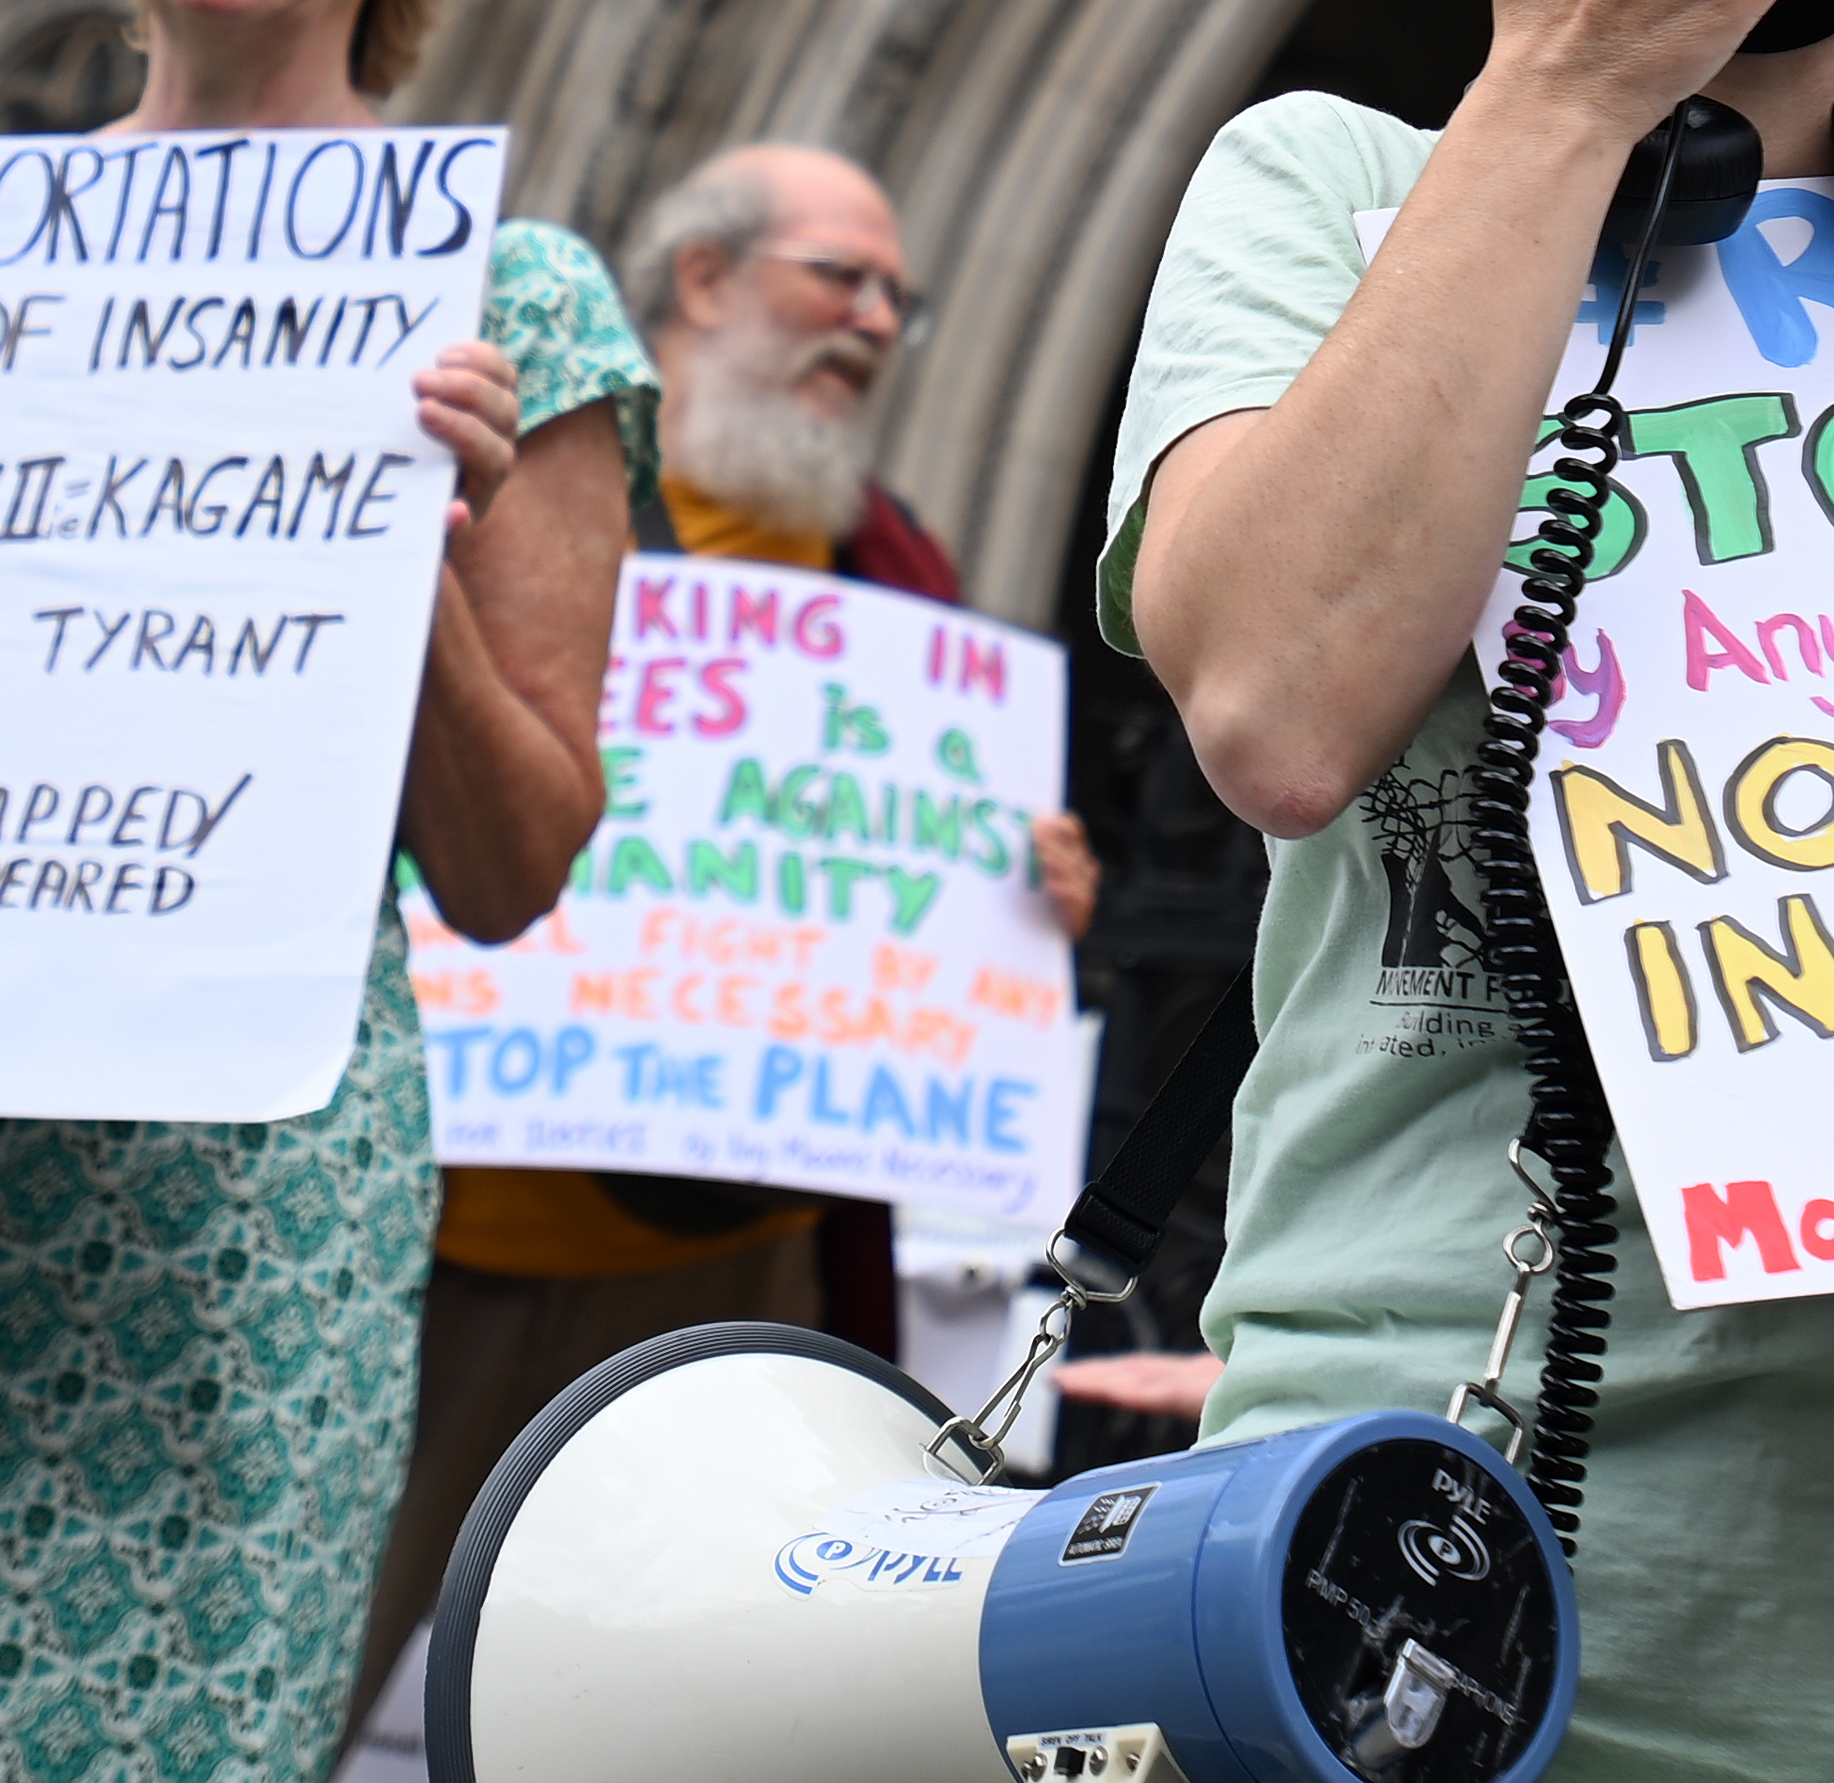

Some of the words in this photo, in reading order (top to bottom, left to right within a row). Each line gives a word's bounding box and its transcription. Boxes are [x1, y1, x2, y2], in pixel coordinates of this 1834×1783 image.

[88, 291, 441, 375] INSANITY
[84, 452, 416, 542] KAGAME
[34, 607, 347, 678] TYRANT
[926, 625, 1010, 704] IN
[575, 837, 941, 936] ANITY
[641, 909, 828, 968] FIGHT
[872, 943, 941, 996] BY
[572, 968, 979, 1071] NECESSARY
[614, 1041, 729, 1109] THE
[753, 1044, 1039, 1157] PLANE
